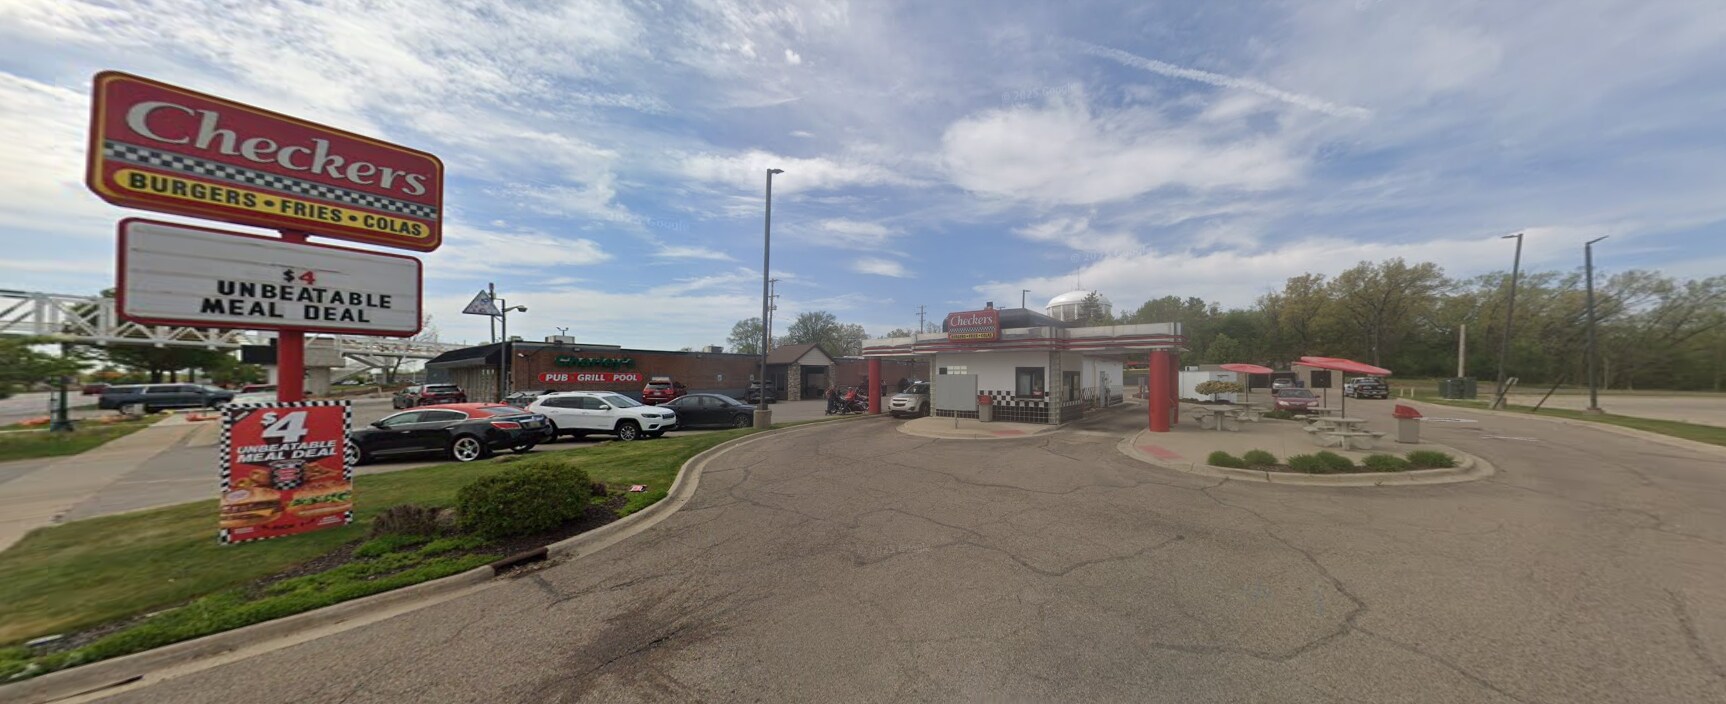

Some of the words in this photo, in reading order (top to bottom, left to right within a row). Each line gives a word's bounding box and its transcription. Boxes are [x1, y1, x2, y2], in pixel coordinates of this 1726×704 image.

[125, 100, 428, 196] Checkers
[128, 172, 257, 208] BURGERS
[281, 199, 342, 223] FRIES
[363, 215, 422, 236] COLAS
[283, 269, 316, 285] $4
[217, 280, 392, 309] UNBEATABLE
[201, 298, 284, 318] MEAL
[304, 305, 370, 323] DEAL
[951, 314, 993, 326] Checkers
[260, 411, 309, 443] $4
[236, 451, 286, 463] MEAL
[291, 447, 338, 459] DEAL
[237, 441, 337, 454] UNBEATABLE
